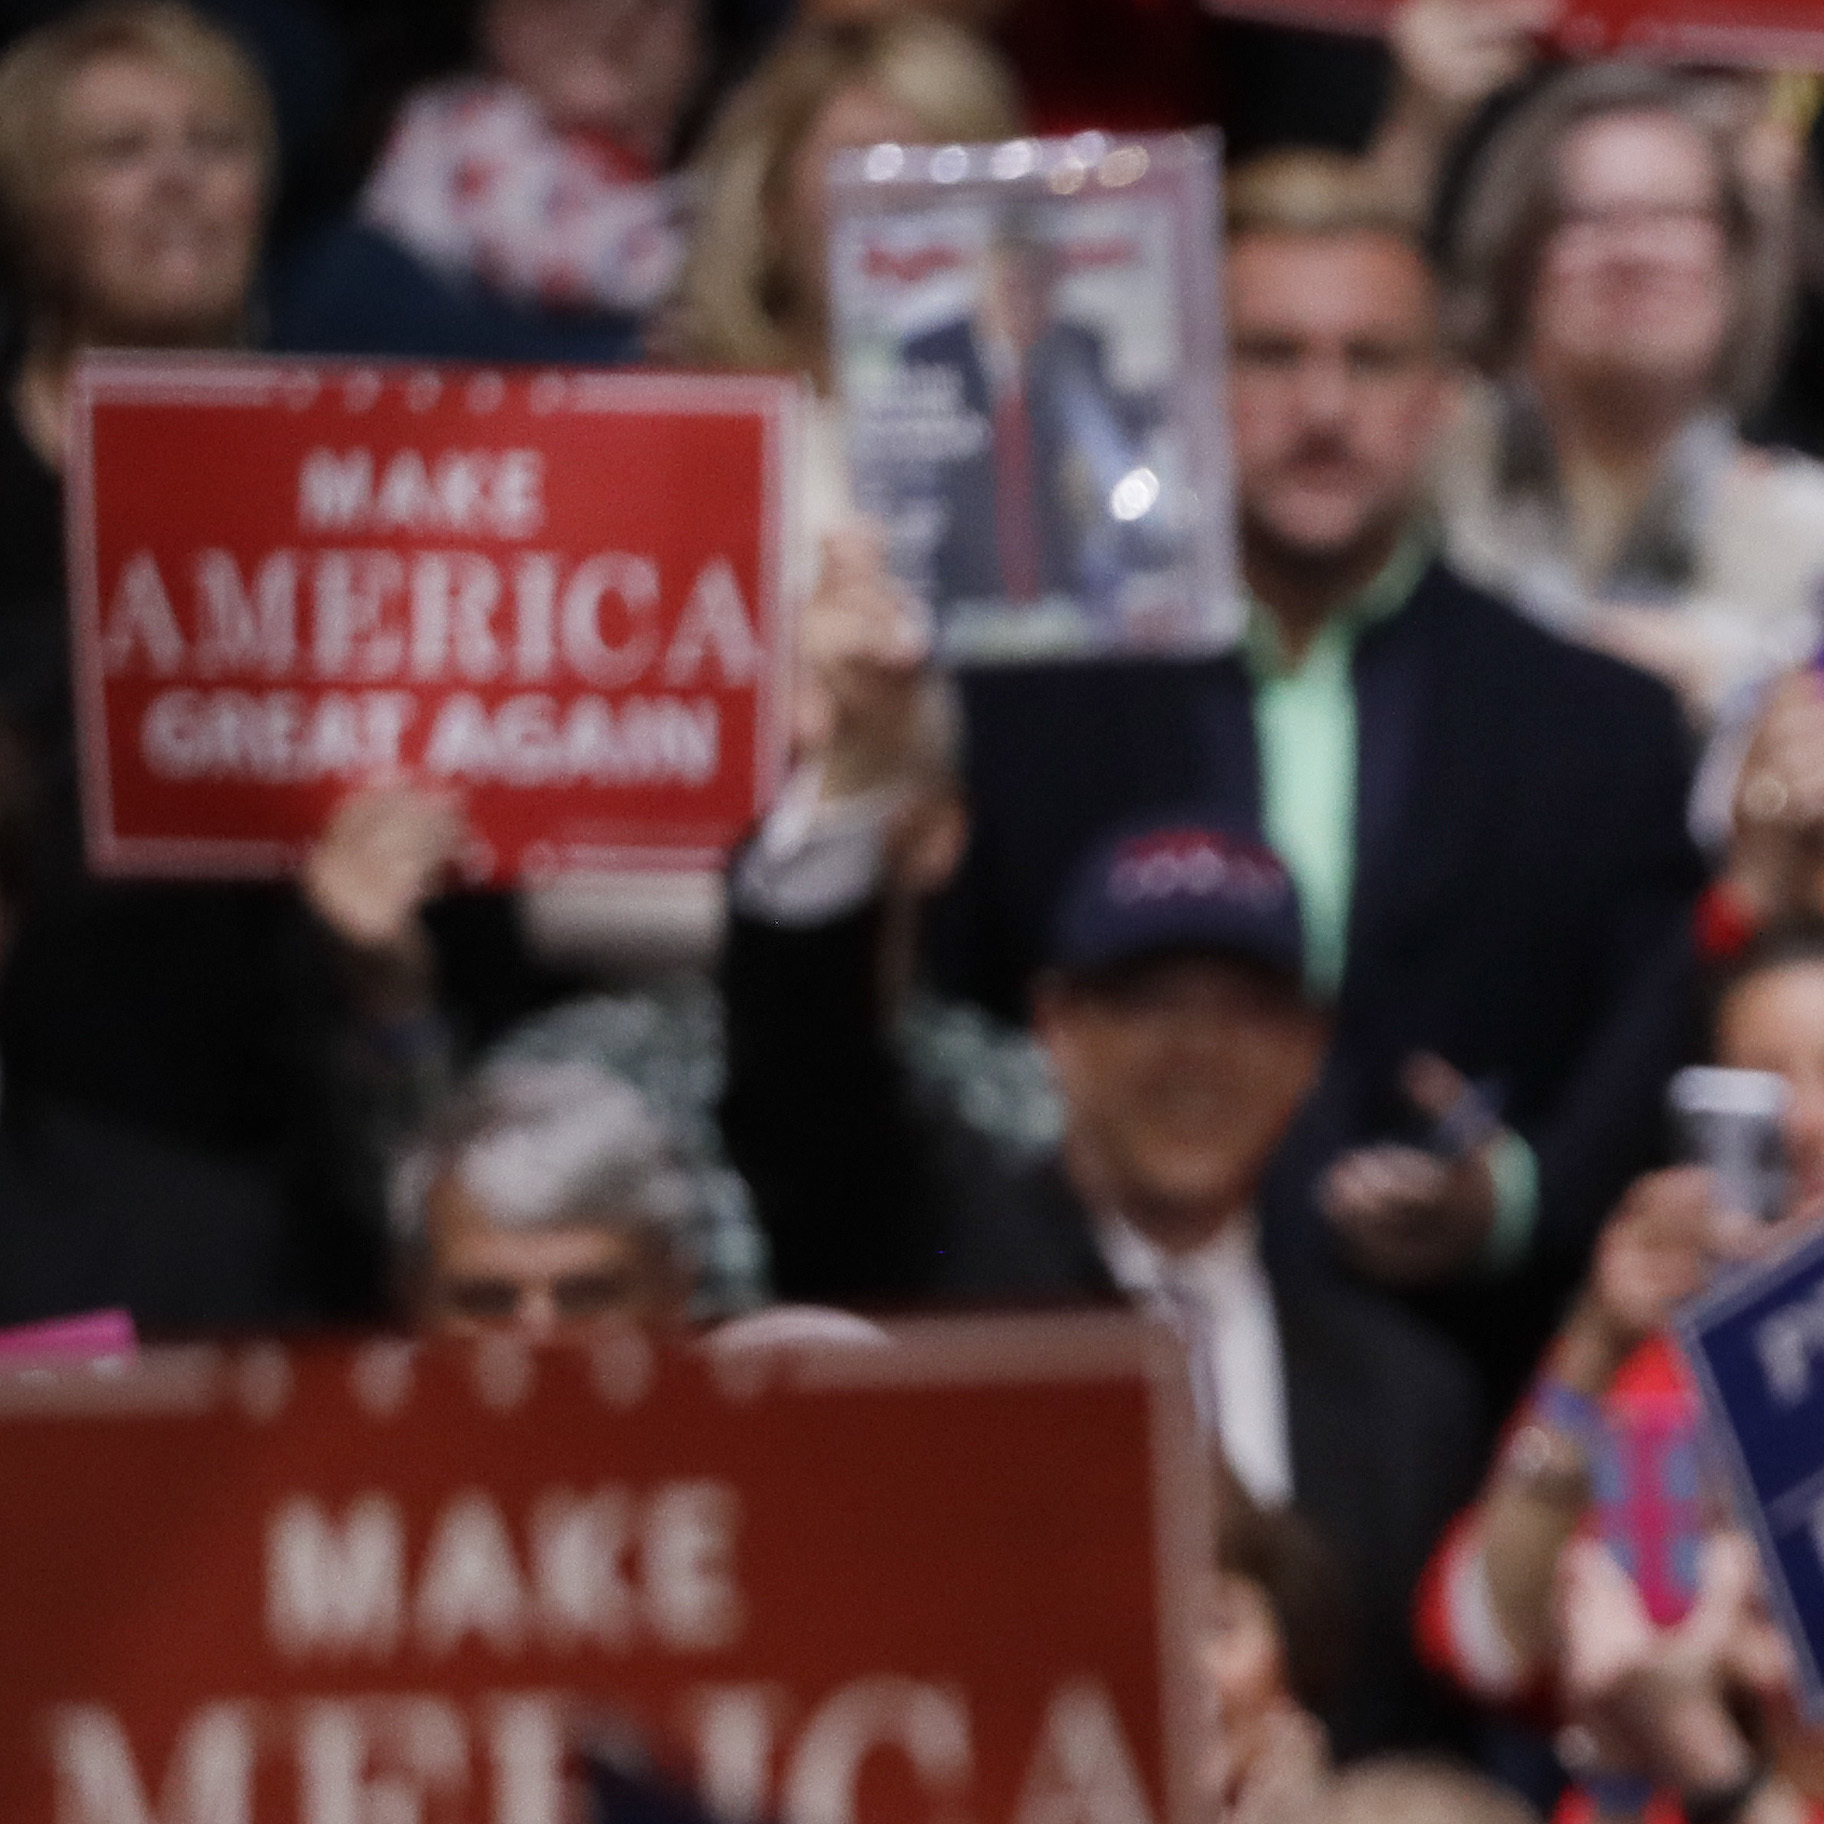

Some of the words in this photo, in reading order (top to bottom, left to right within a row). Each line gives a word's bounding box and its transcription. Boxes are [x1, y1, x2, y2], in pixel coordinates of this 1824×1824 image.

[297, 444, 548, 540] MAKE
[104, 547, 766, 690] AMERICA
[140, 686, 416, 785] GREAT
[424, 692, 722, 792] AGAIN
[262, 1478, 748, 1664] MAKE
